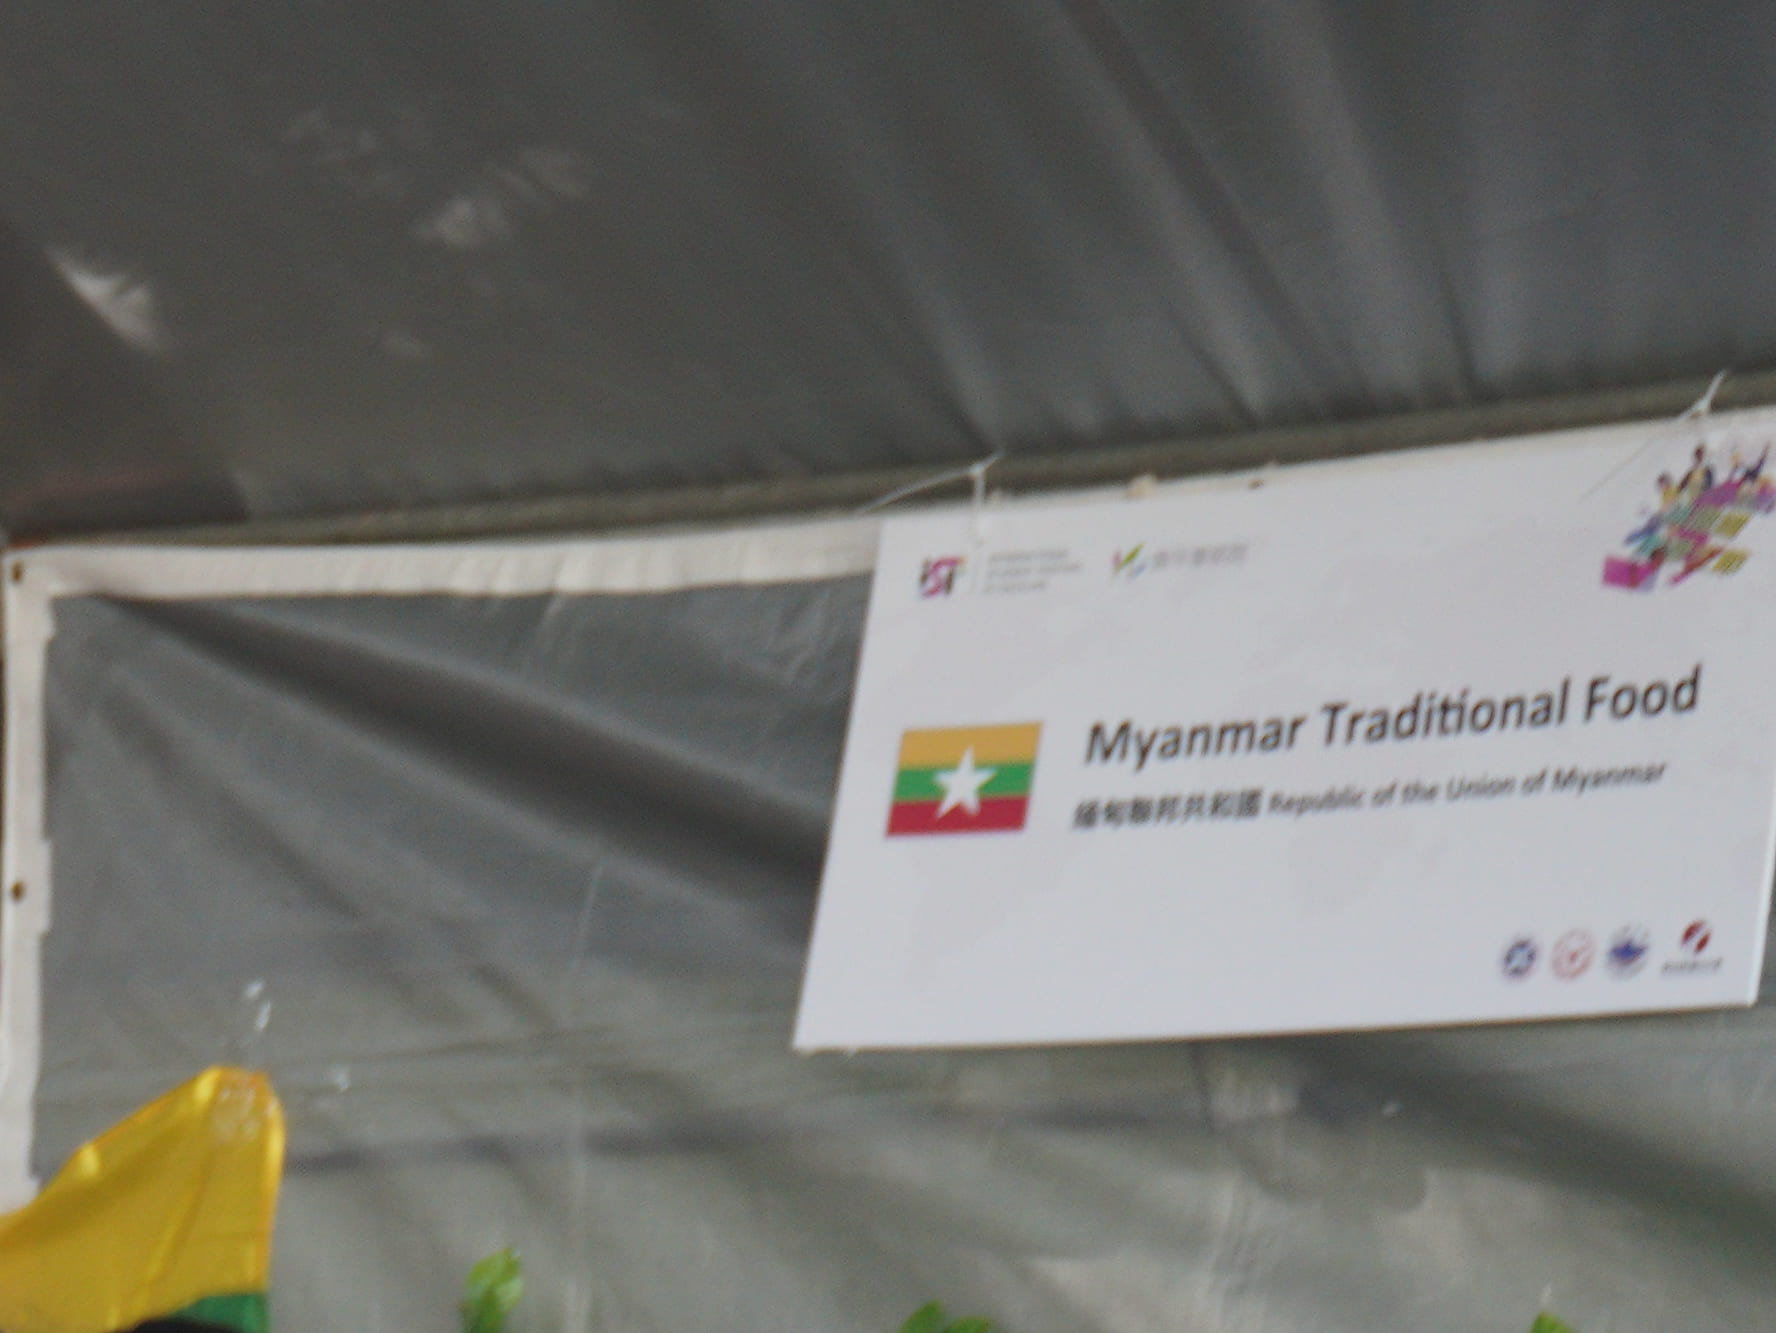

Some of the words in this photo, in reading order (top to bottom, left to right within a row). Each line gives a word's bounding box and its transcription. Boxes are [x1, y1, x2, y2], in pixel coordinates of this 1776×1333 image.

[1084, 715, 1308, 773] Myanmar
[1320, 675, 1572, 746] Traditional
[1583, 660, 1704, 724] Food
[1268, 784, 1366, 818] Republic
[1370, 782, 1397, 806] of
[1401, 777, 1439, 804] the
[1447, 773, 1516, 801] Union
[1521, 767, 1547, 795] of
[1551, 762, 1667, 797] Myanmar
